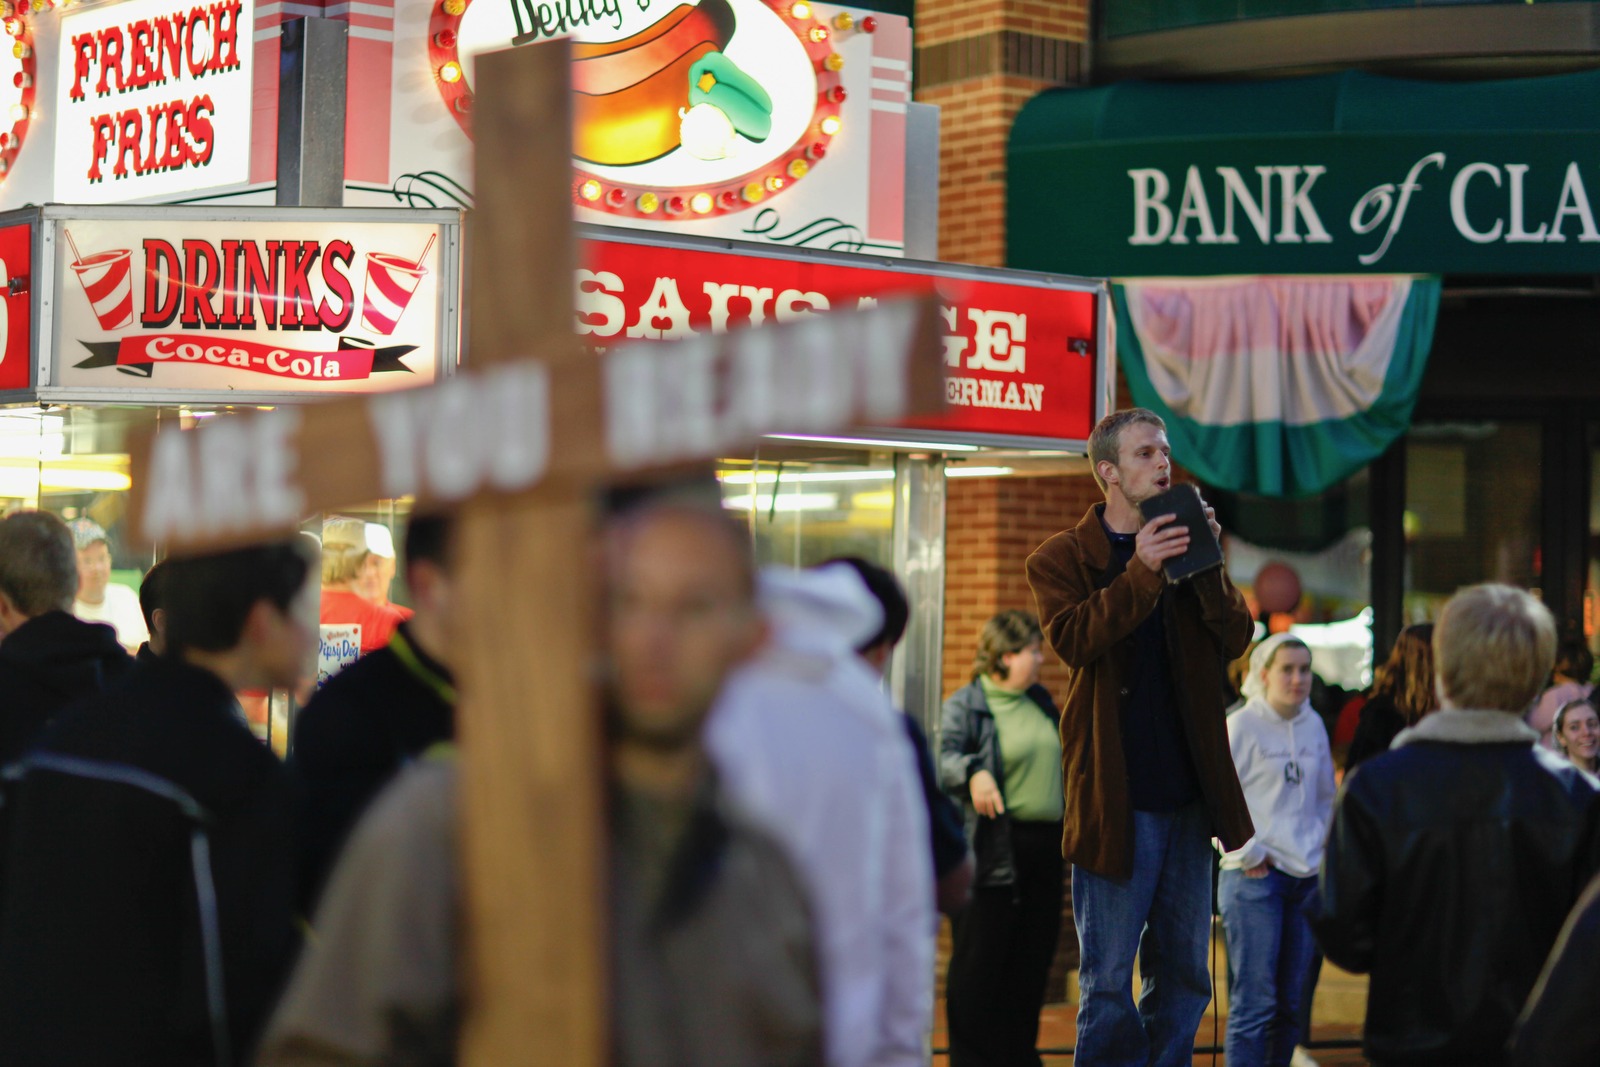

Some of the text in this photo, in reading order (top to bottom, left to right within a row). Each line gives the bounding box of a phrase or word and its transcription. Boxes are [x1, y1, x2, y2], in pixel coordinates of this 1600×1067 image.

[70, 0, 241, 103] FRENCH
[511, 0, 651, 46] Denny
[87, 93, 215, 184] FRIES
[1127, 152, 1600, 266] BANK of CLA
[140, 238, 356, 333] DRINKS
[145, 336, 341, 378] Coca-Cola
[945, 377, 1045, 412] ERMAN
